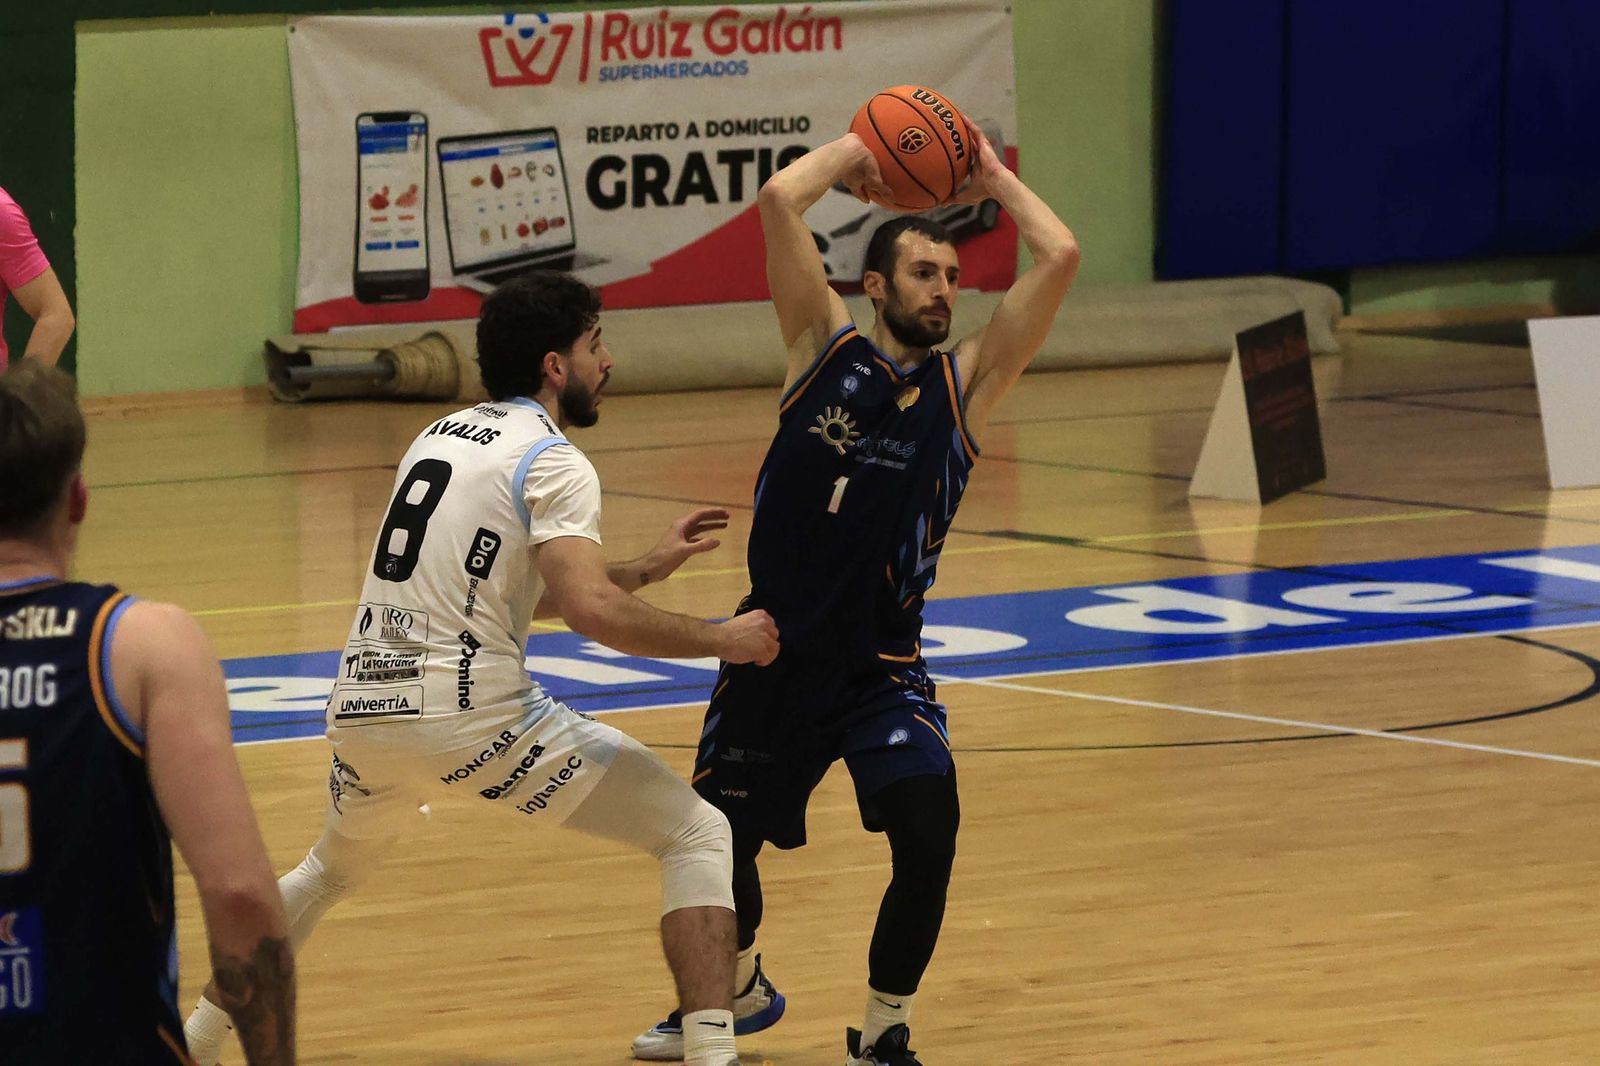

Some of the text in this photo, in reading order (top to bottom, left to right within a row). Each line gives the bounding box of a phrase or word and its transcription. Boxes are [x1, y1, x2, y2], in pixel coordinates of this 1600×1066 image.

[601, 7, 843, 62] Ruiz Galán
[599, 60, 749, 82] SUPERMERCADOS
[586, 116, 811, 144] REPARTO A DOMICILIO
[911, 88, 966, 160] Wilson
[827, 475, 850, 514] 1
[373, 458, 453, 582] 8
[0, 605, 77, 640] SKIJ
[382, 607, 413, 630] ORO
[440, 730, 519, 785] MONGAR
